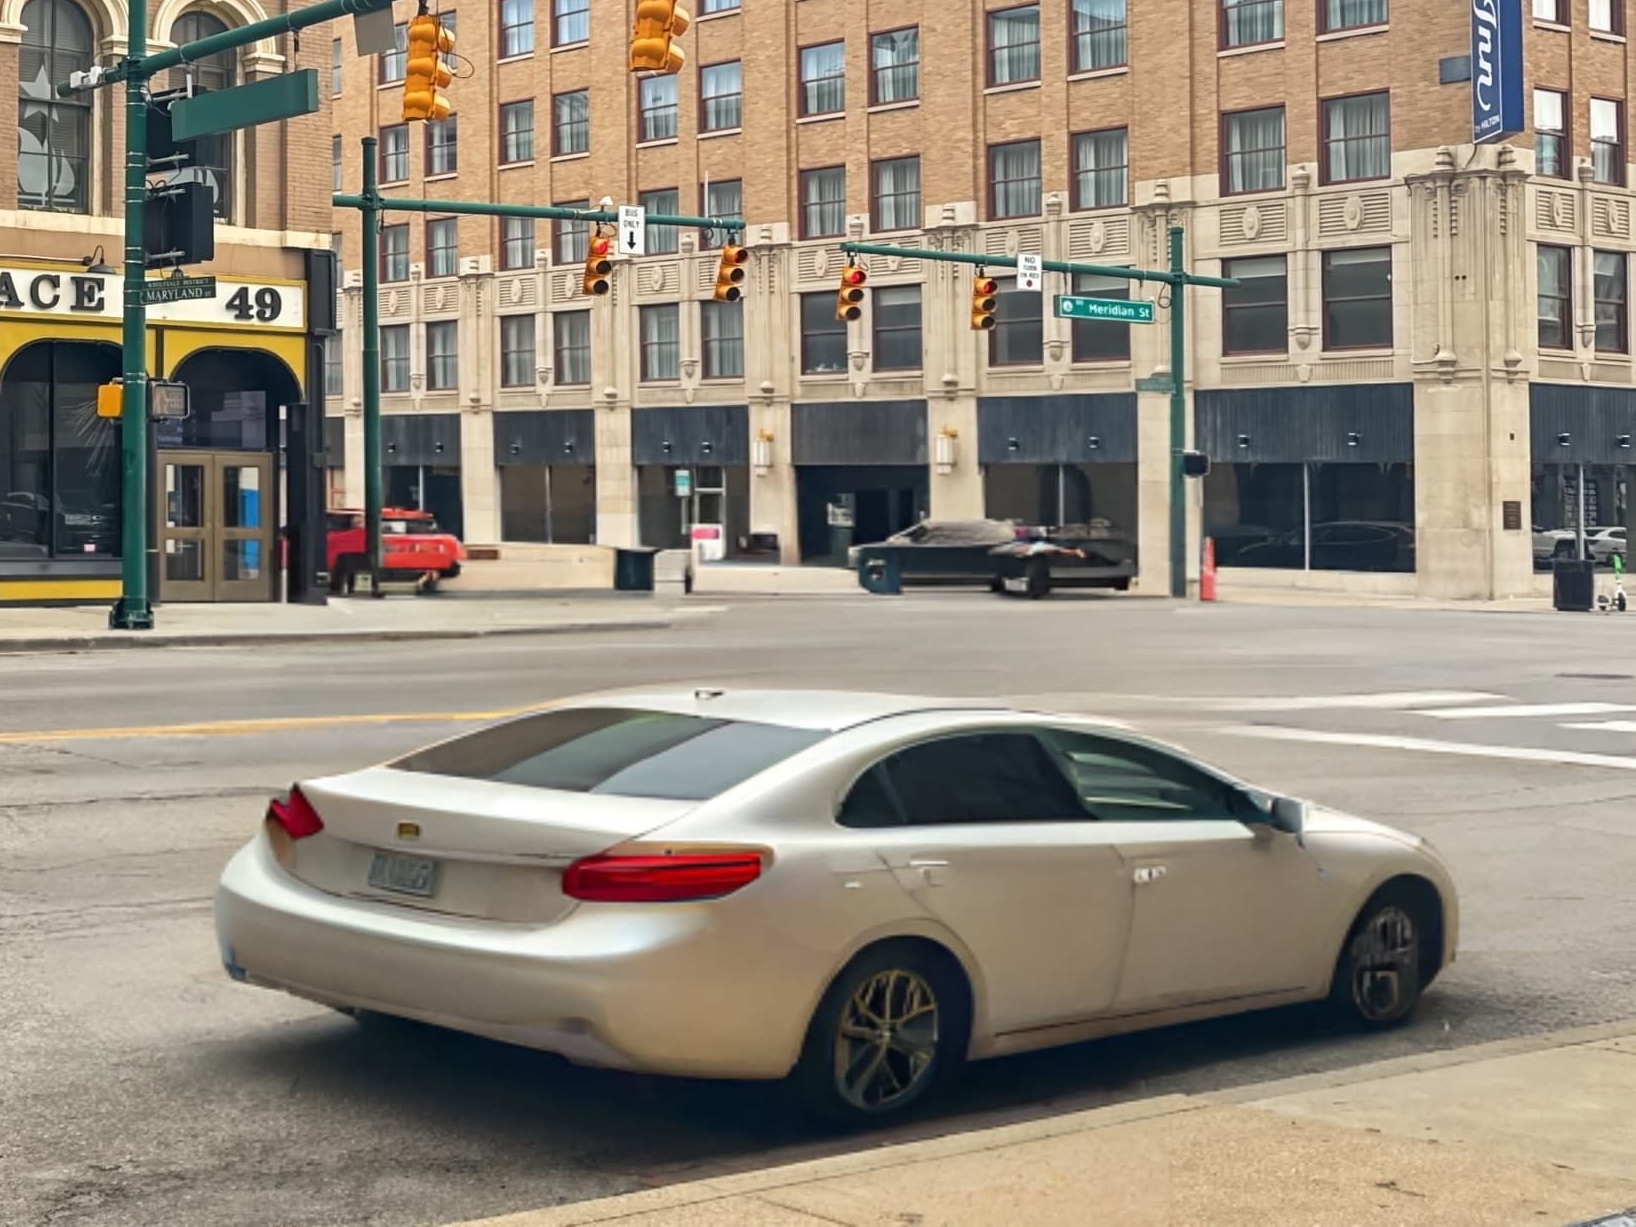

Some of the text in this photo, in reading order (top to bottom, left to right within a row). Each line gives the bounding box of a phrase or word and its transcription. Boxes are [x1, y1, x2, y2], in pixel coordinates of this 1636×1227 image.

[625, 208, 638, 217] BUS
[623, 220, 640, 229] ONLY
[146, 287, 203, 302] MARYLAND
[226, 286, 282, 321] 49
[1089, 304, 1150, 318] Meridian St
